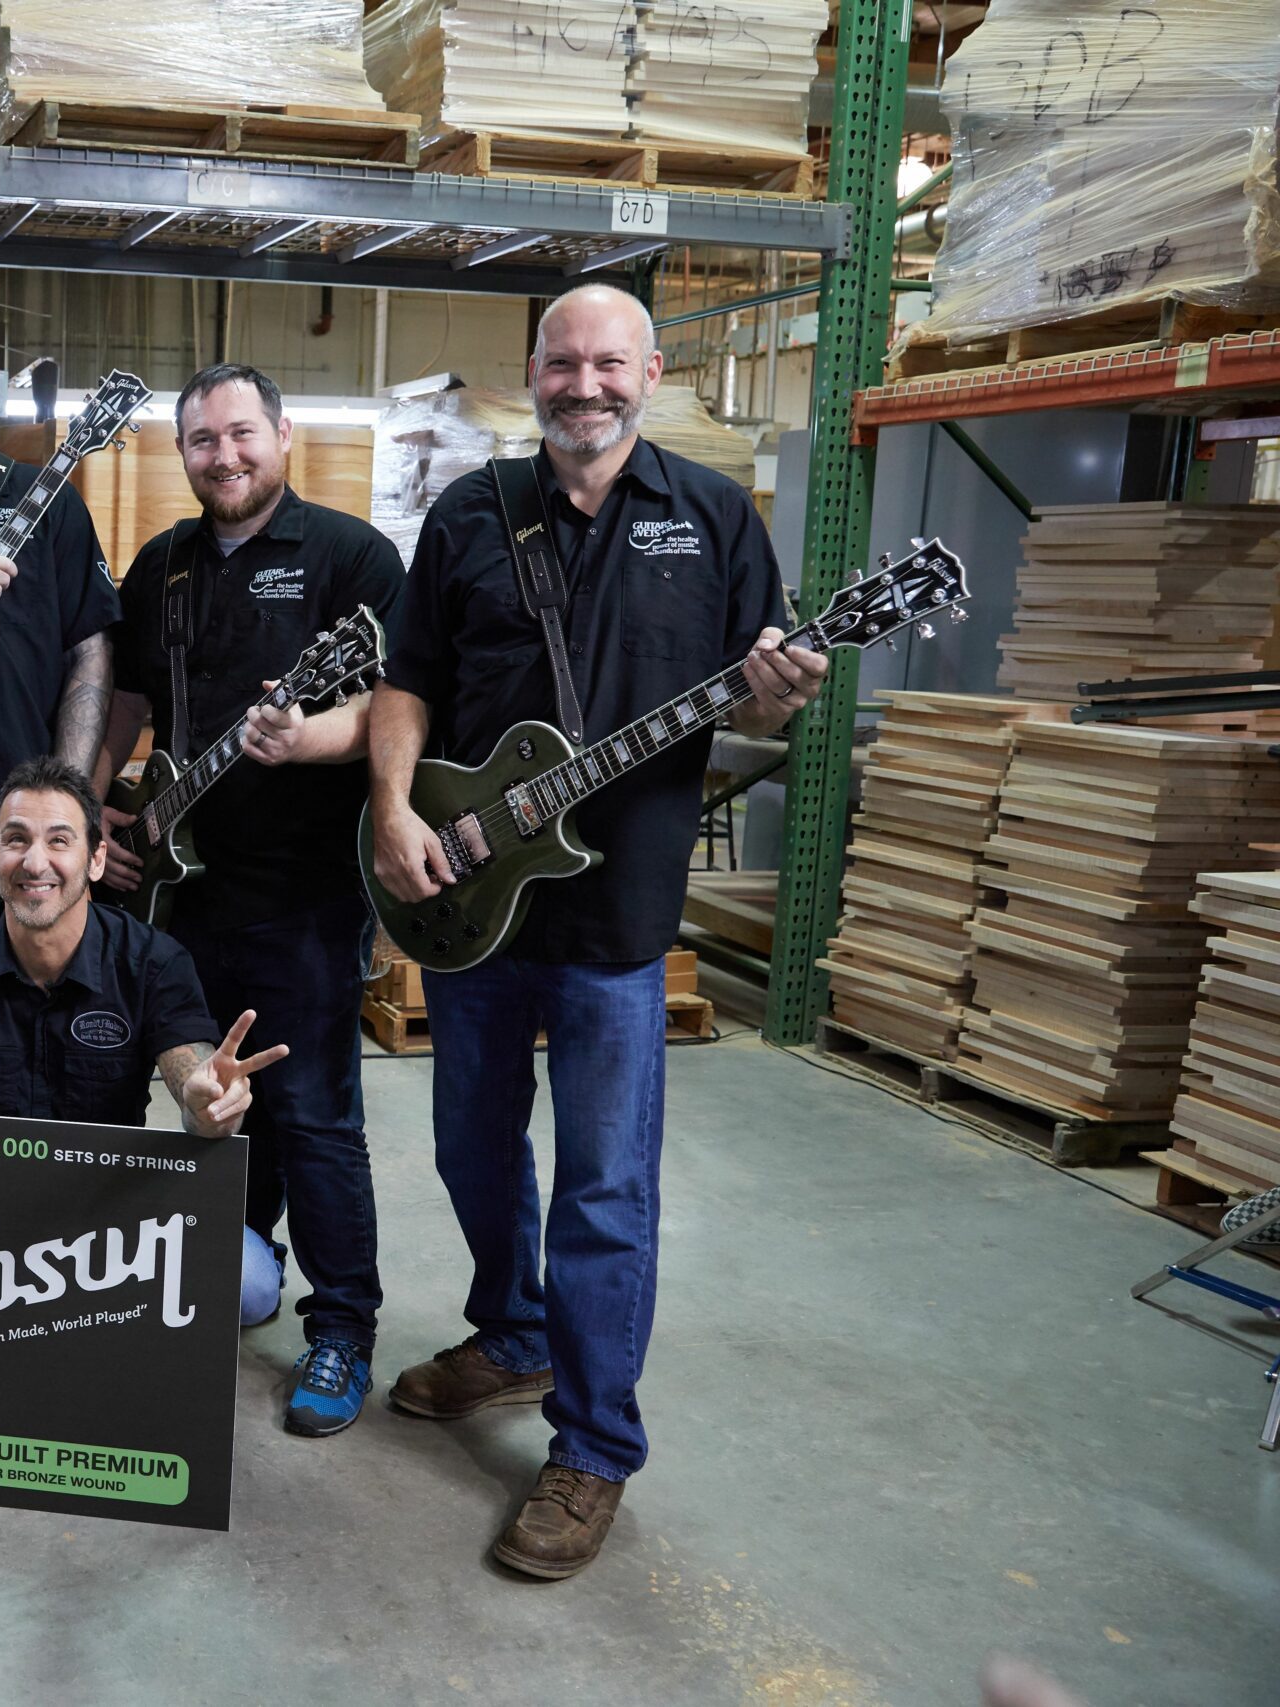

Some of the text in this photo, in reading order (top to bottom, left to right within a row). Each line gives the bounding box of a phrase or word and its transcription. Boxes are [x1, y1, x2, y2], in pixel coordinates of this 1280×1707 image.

[222, 175, 234, 197] C
[620, 201, 654, 224] C7 D
[116, 378, 140, 393] Gibson
[516, 522, 545, 544] Gibson
[632, 519, 674, 530] GUITARS
[637, 529, 661, 537] VETS
[652, 542, 670, 551] power
[655, 547, 673, 555] hands
[681, 547, 701, 555] heroes
[678, 536, 699, 545] healing
[167, 571, 189, 588] Gibson
[255, 568, 286, 577] GUITARS
[924, 557, 957, 589] Gibson
[356, 624, 374, 652] Gibson
[54, 1149, 94, 1164] SETS
[99, 1153, 120, 1166] OF
[125, 1155, 197, 1173] STRINGS
[8, 1324, 49, 1342] Made,
[52, 1314, 93, 1332] World
[56, 1448, 178, 1480] PREMIUM
[7, 1469, 67, 1486] BRONZE
[70, 1476, 126, 1492] WOUND
